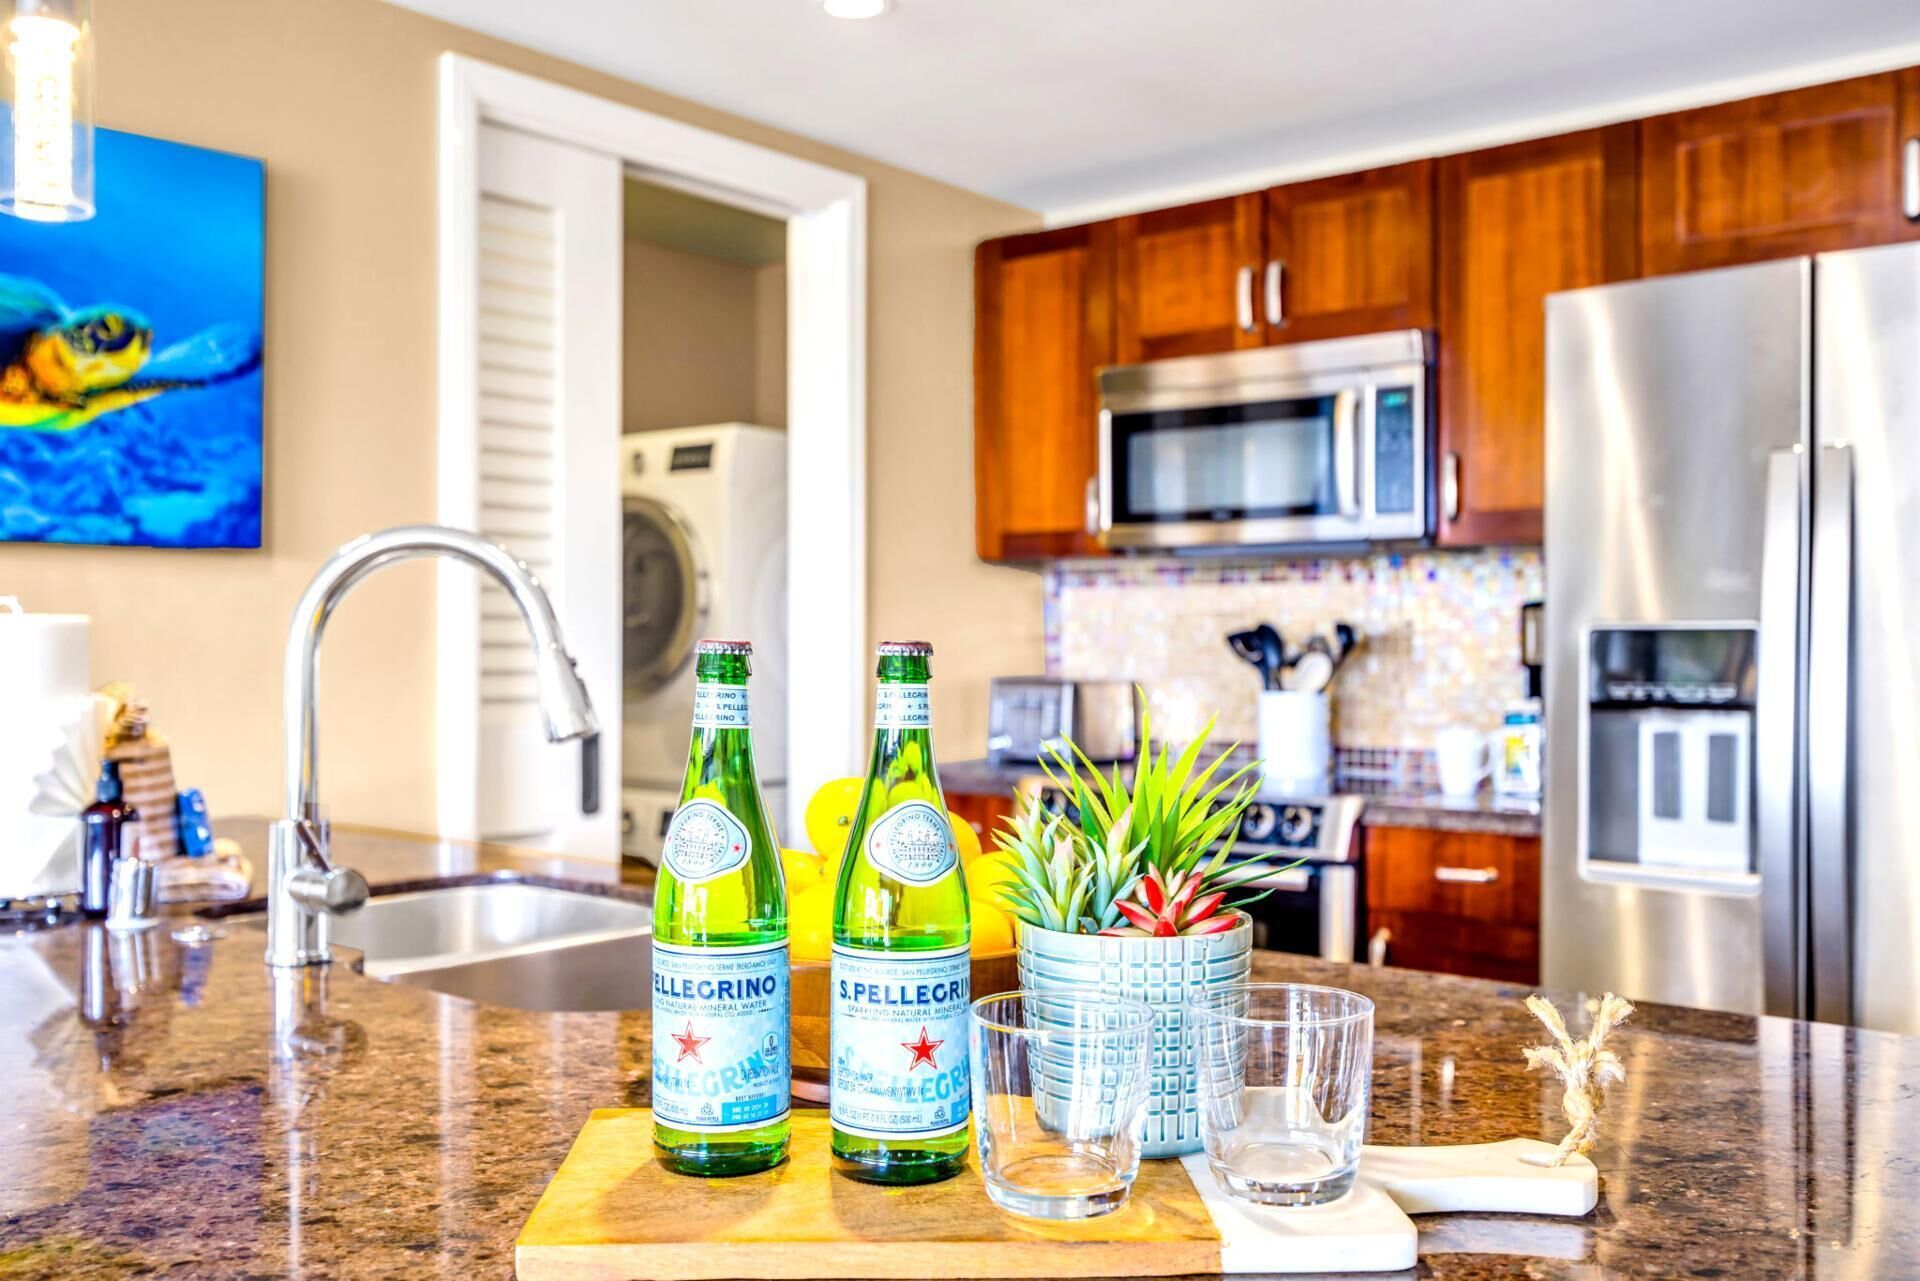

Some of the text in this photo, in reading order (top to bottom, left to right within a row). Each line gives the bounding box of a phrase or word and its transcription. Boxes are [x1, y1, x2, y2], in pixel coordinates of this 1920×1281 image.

[653, 973, 776, 1000] ELLEGRINO
[665, 999, 697, 1011] NATURAL
[699, 1002, 738, 1012] MINERAL
[741, 999, 767, 1010] WATER
[848, 1004, 889, 1017] SPARKLING
[892, 1009, 931, 1017] NATURAL
[935, 1003, 962, 1014] MINERAL
[768, 1035, 774, 1047] 0
